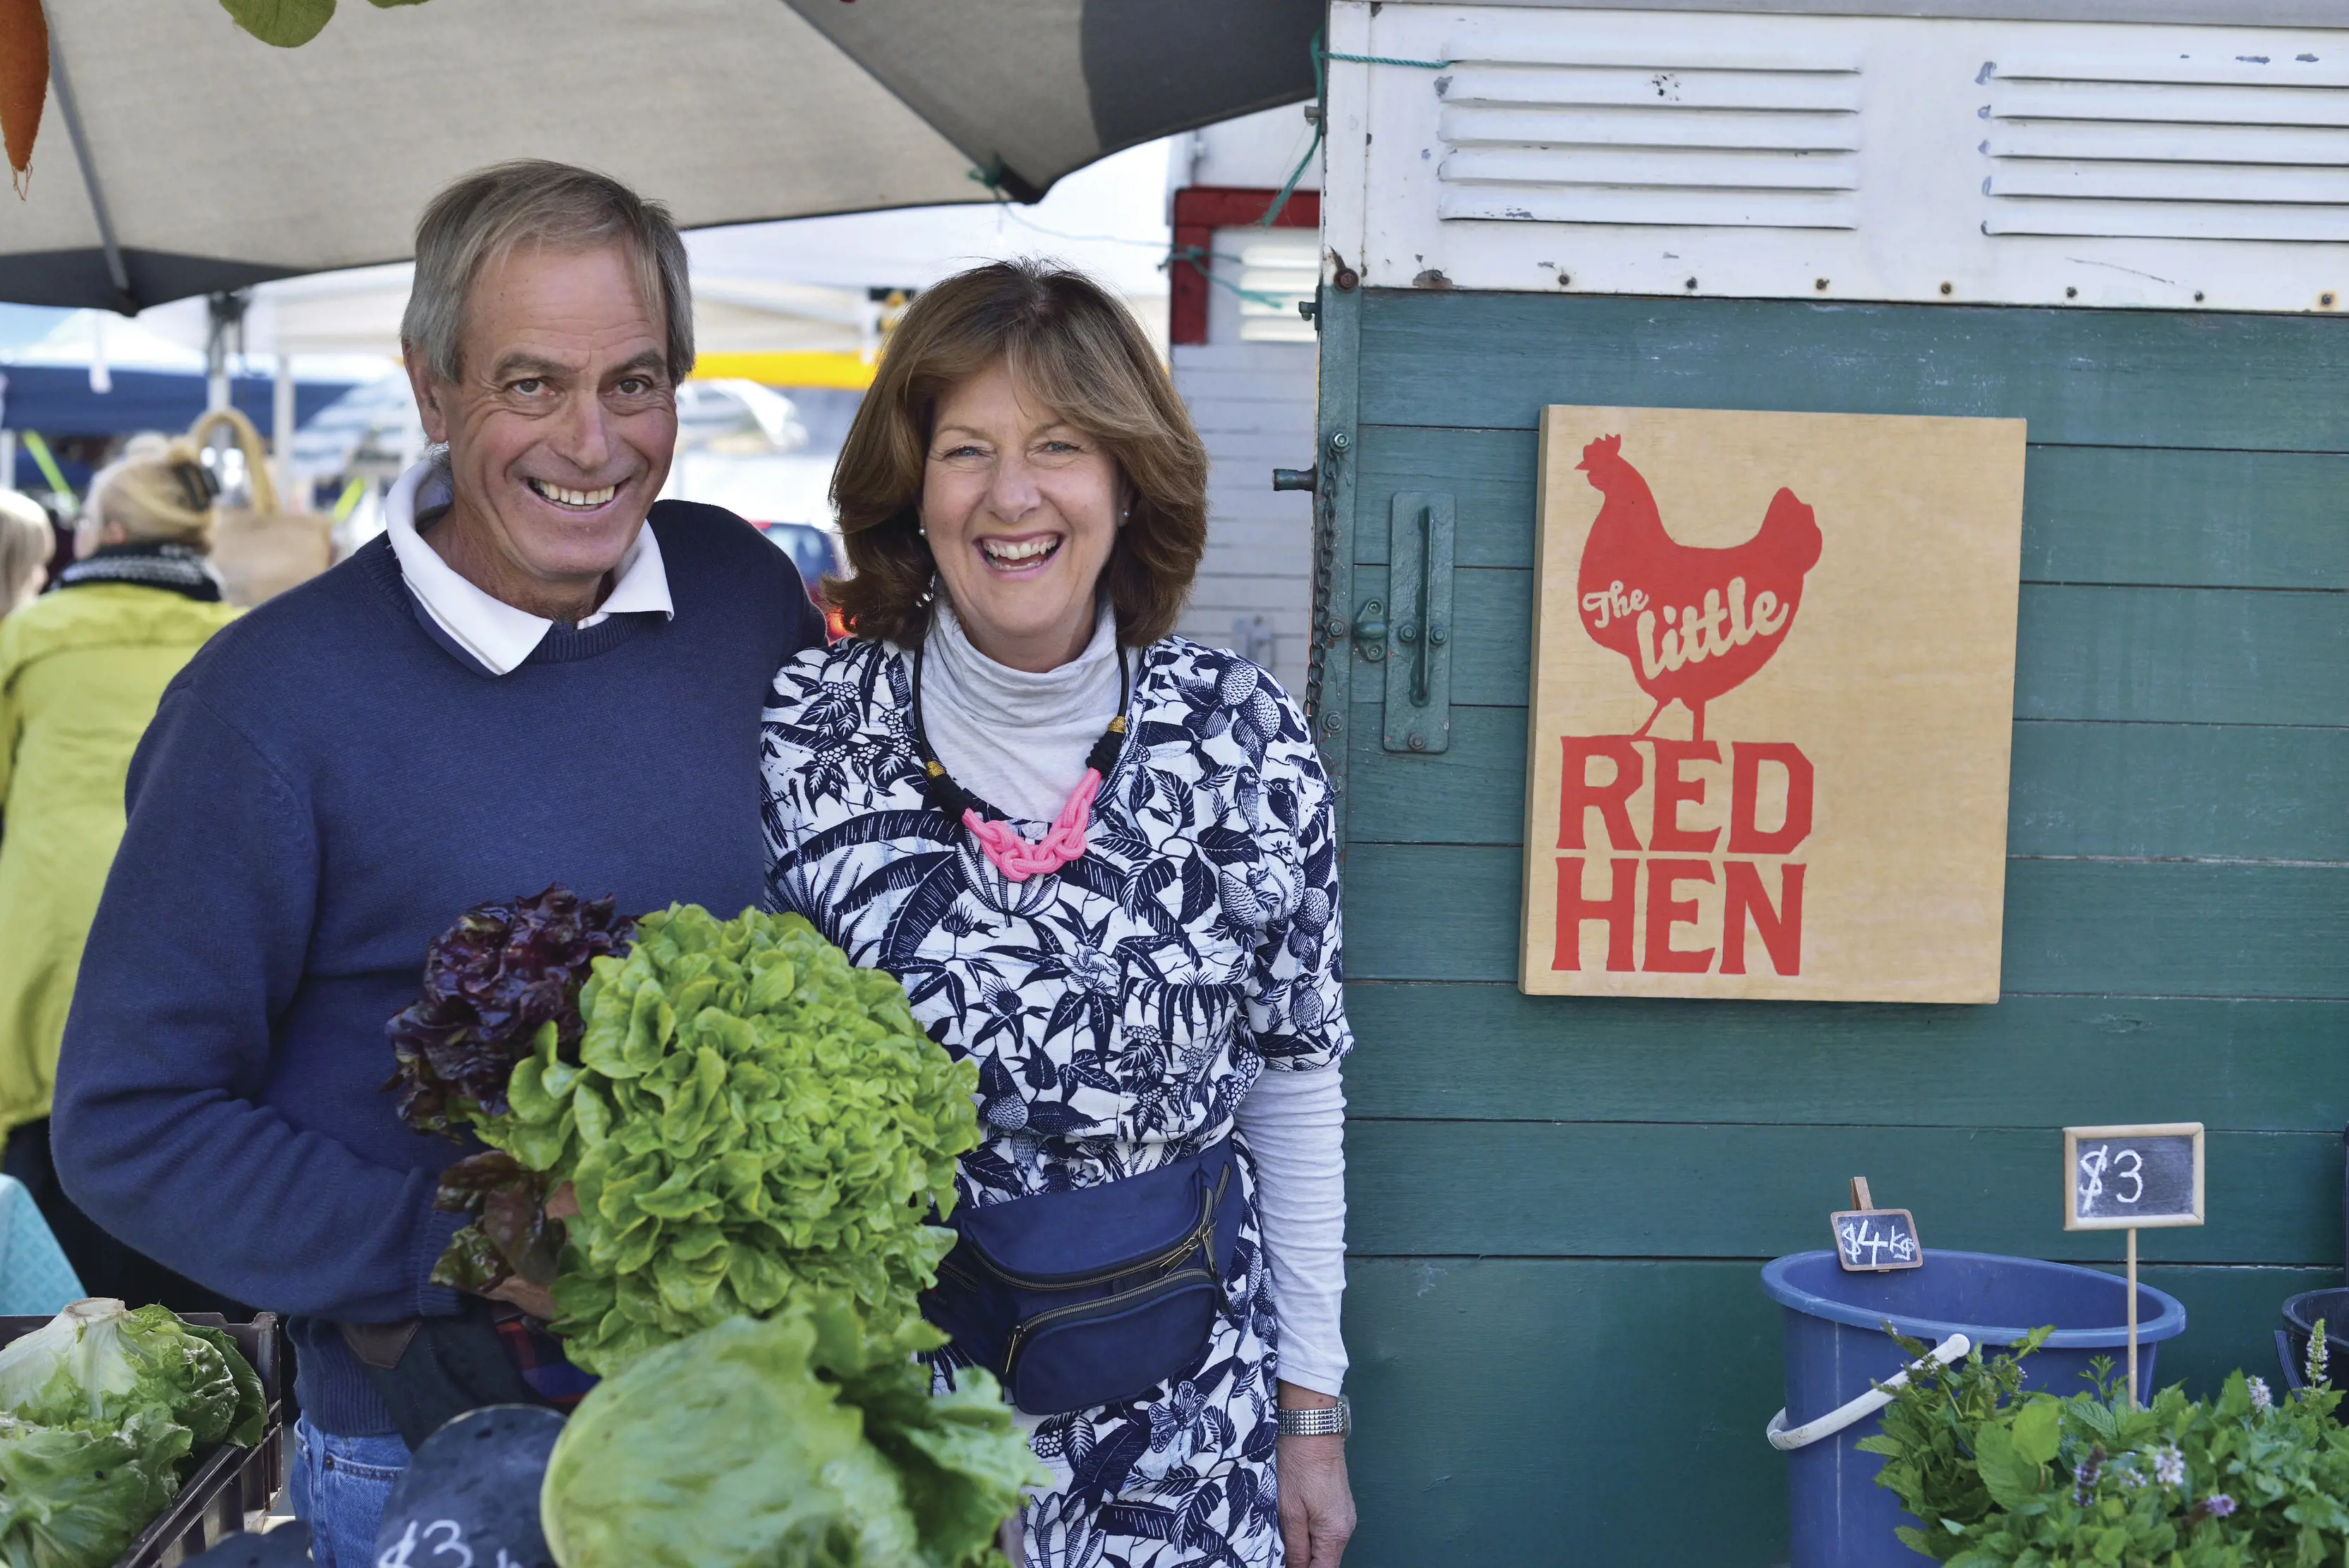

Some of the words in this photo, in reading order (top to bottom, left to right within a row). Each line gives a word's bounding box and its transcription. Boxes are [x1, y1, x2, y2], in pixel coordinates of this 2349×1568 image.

[1582, 580, 1650, 629] The
[1636, 576, 1789, 681] little
[1555, 735, 1814, 855] RED
[1550, 856, 1808, 977] HEN
[2078, 1144, 2144, 1212] $3
